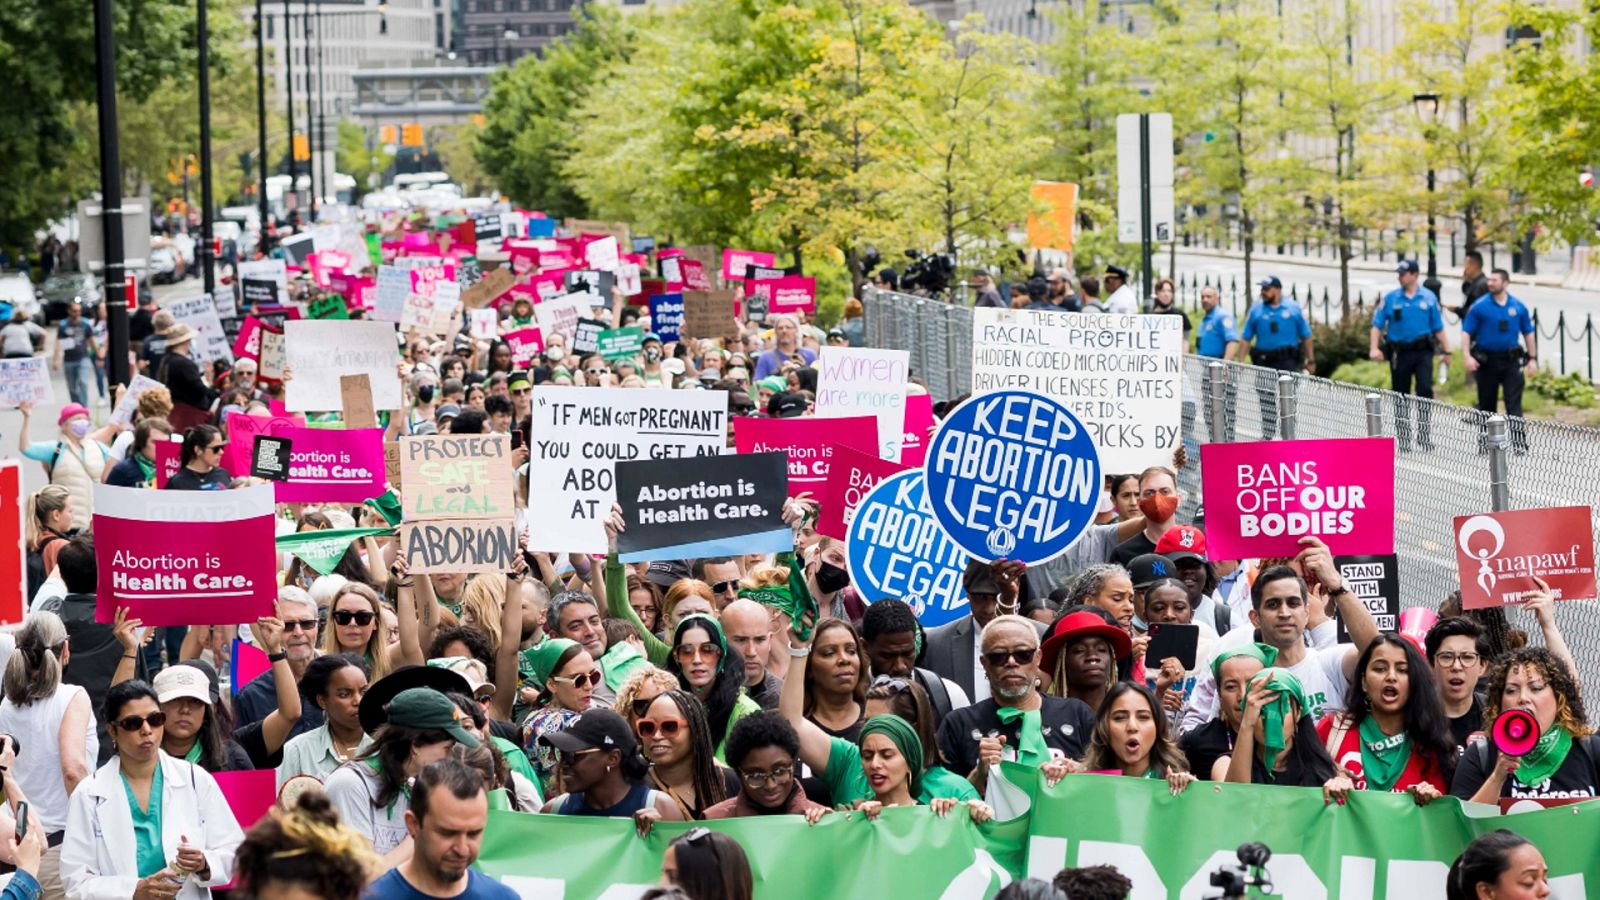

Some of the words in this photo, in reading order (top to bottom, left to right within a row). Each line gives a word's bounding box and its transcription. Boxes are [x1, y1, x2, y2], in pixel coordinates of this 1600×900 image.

[1029, 312, 1055, 327] THE
[1060, 314, 1112, 330] SOURCE
[1119, 316, 1136, 330] OF
[1142, 316, 1180, 331] NYPD
[984, 326, 1049, 346] RACIAL
[1069, 330, 1161, 349] PROFILE
[975, 350, 1021, 368] HIDDEN
[1026, 351, 1070, 370] CODED
[1074, 353, 1158, 373] MICROCHIPS
[1165, 356, 1179, 374] IN
[818, 389, 848, 406] are
[856, 391, 900, 407] more
[975, 373, 1029, 390] DRIVER
[1117, 379, 1174, 399] PLATES
[579, 406, 612, 427] MEN
[639, 408, 723, 431] PREGNANT
[973, 396, 1077, 450] KEEP
[409, 438, 502, 460] PROTECT
[1155, 425, 1179, 449] BY
[290, 451, 336, 464] bortion
[339, 450, 350, 464] is
[537, 440, 570, 460] YOU
[582, 442, 639, 460] COULD
[649, 444, 683, 460] GET
[695, 445, 720, 457] AN
[821, 444, 833, 457] is
[288, 464, 328, 478] ealth
[331, 465, 373, 479] Care.
[419, 460, 490, 485] SAFE
[849, 467, 885, 490] BA
[936, 429, 1093, 505] ABORTION
[1237, 461, 1318, 488] BANS
[562, 468, 612, 492] ABO
[637, 481, 733, 503] Abortion
[737, 479, 756, 497] is
[416, 494, 498, 514] LEGAL
[571, 500, 599, 519] AT
[944, 478, 1070, 544] LEGAL
[1236, 487, 1296, 513] OFF
[1300, 485, 1366, 511] OUR
[639, 505, 709, 525] Health
[714, 501, 769, 520] Care.
[1240, 510, 1354, 538] BODIES
[407, 523, 516, 569] ABORION
[858, 501, 969, 571] ABORTI
[112, 549, 200, 570] Abortion
[205, 550, 221, 569] is
[1342, 565, 1382, 578] STAND
[1496, 544, 1580, 576] napawf
[113, 572, 187, 591] Health
[193, 573, 254, 590] Care.
[1363, 600, 1385, 611] ACK
[1376, 617, 1394, 628] MEN
